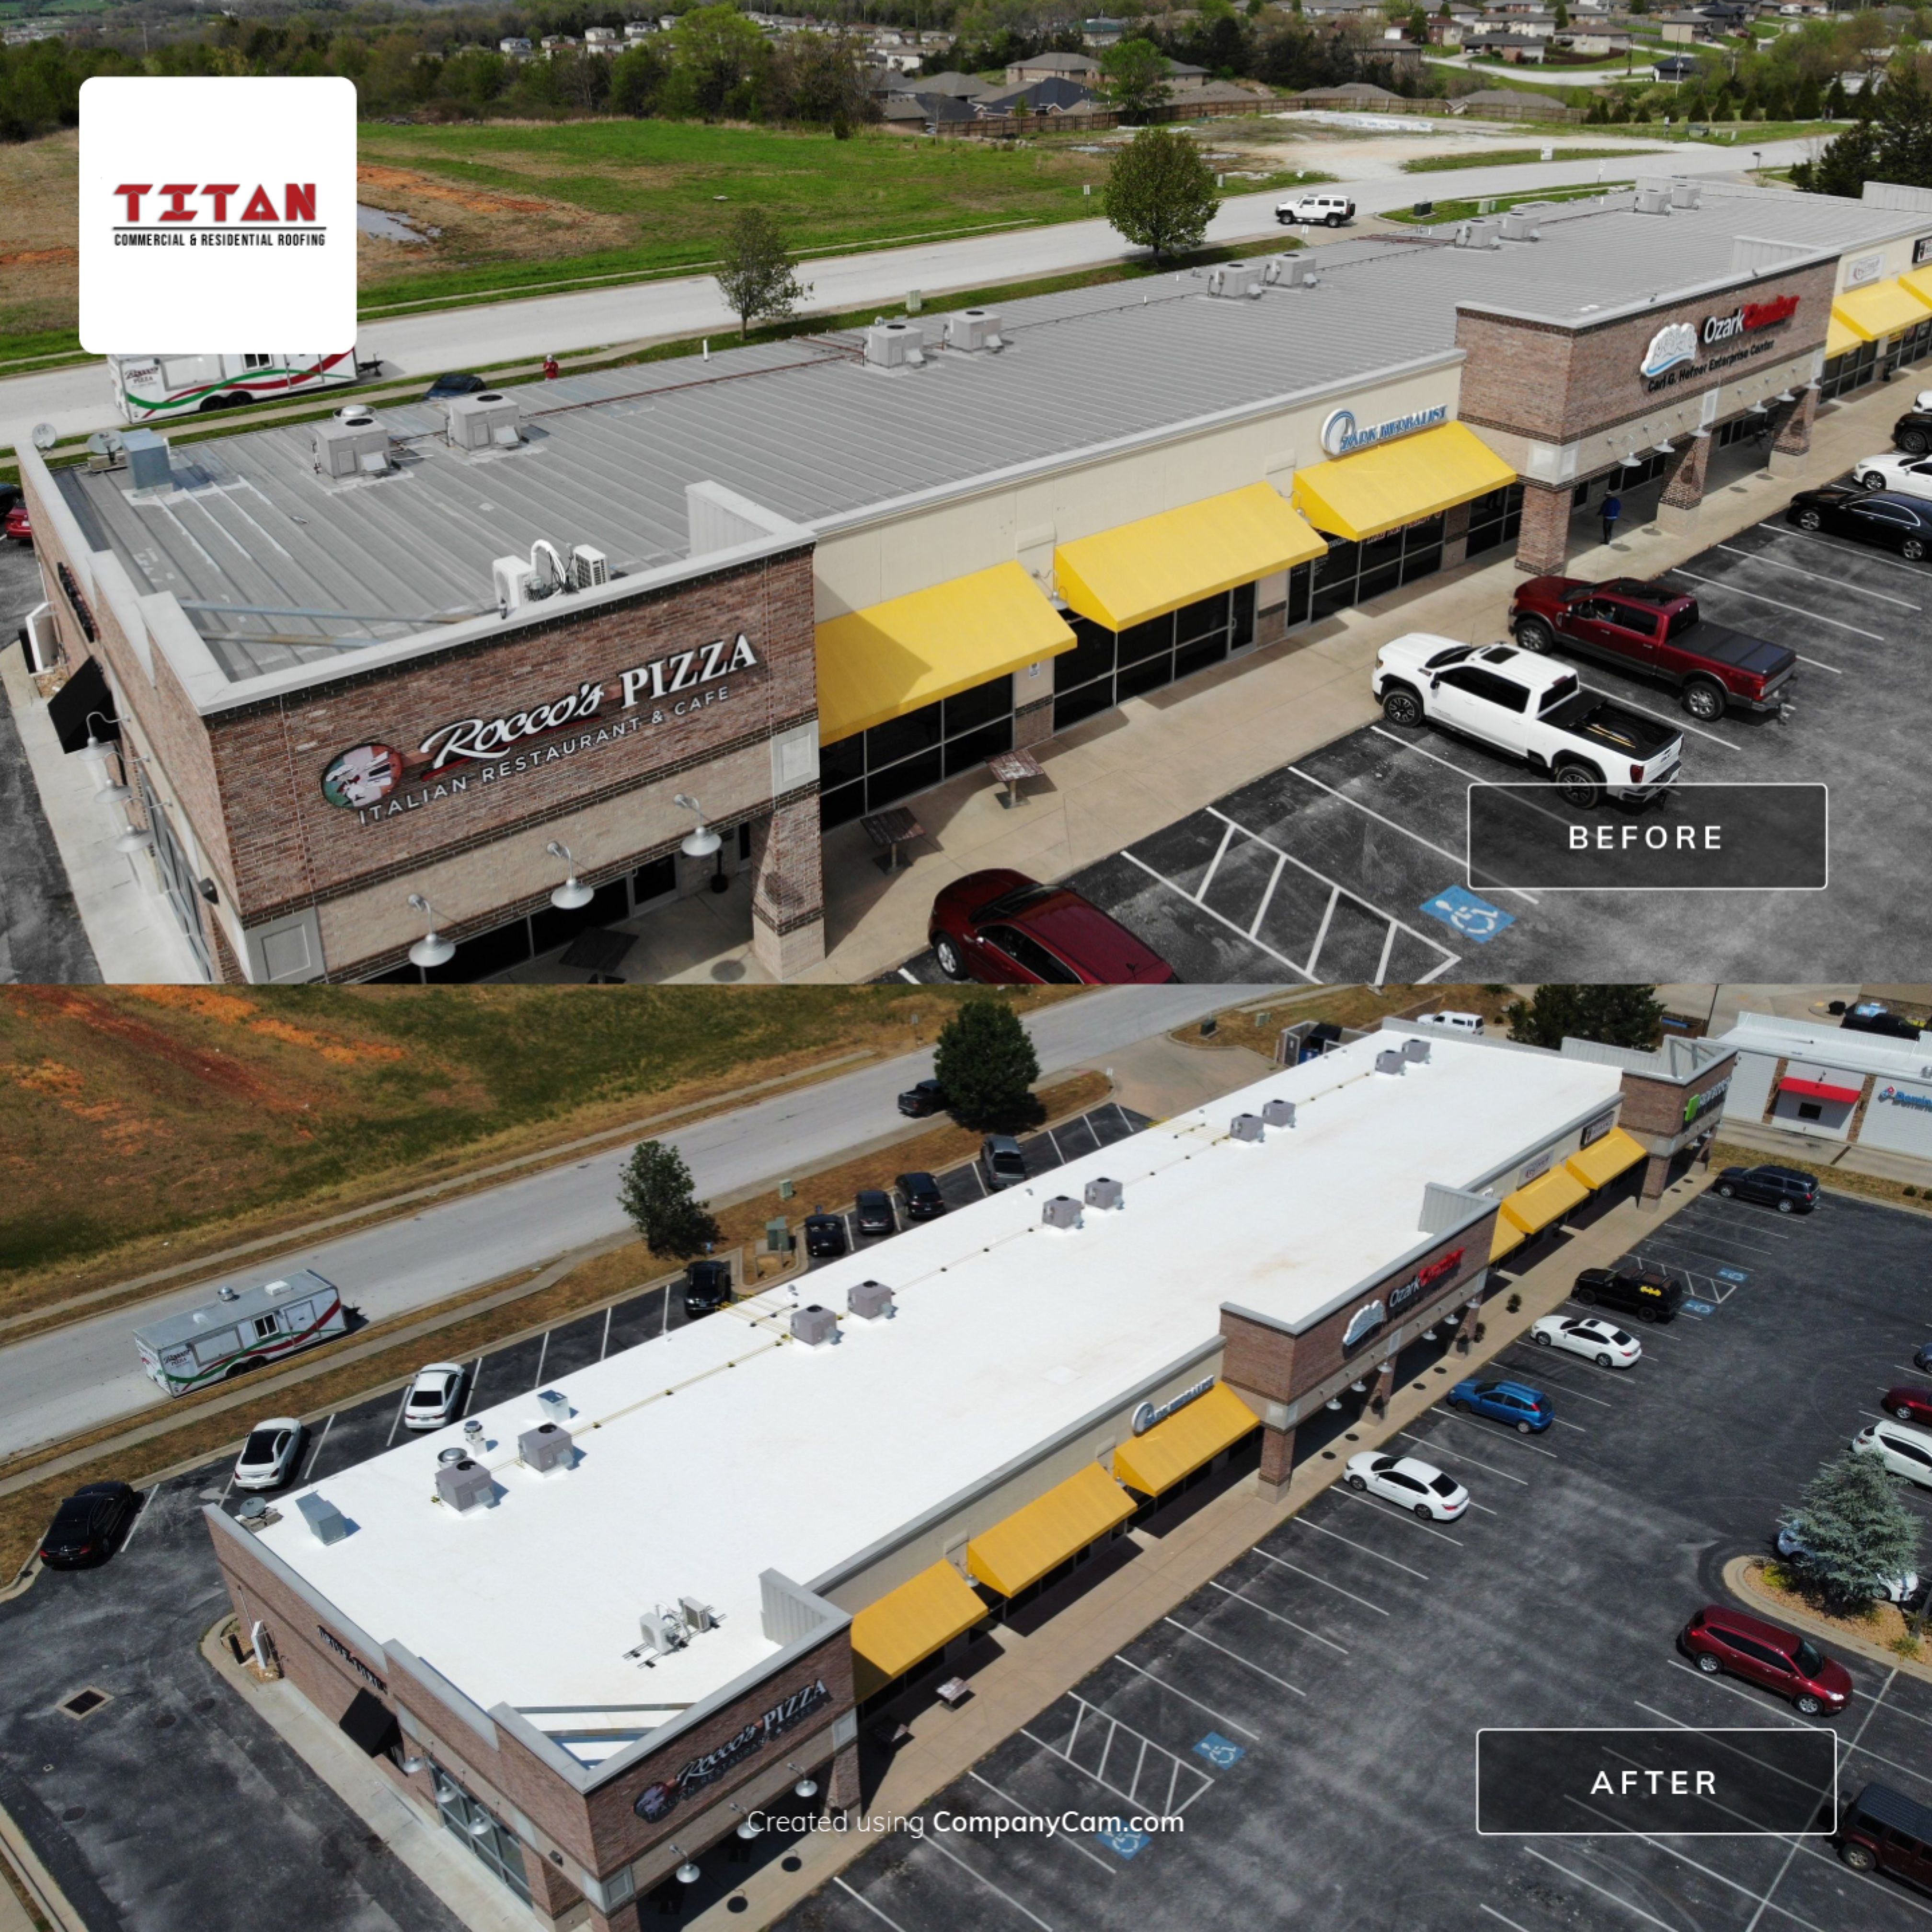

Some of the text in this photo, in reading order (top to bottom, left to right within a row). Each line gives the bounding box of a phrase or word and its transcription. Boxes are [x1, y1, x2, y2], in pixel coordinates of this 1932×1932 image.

[1648, 375, 1667, 392] Carl
[1709, 349, 1748, 371] Enterprise
[1751, 340, 1774, 356] Center
[1704, 309, 1745, 344] Ozark
[359, 686, 729, 825] ITALIAN RESTAURANT & CAFE
[419, 634, 758, 769] Rocco's PIZZA
[676, 1678, 827, 1787] Rocco's PIZZA
